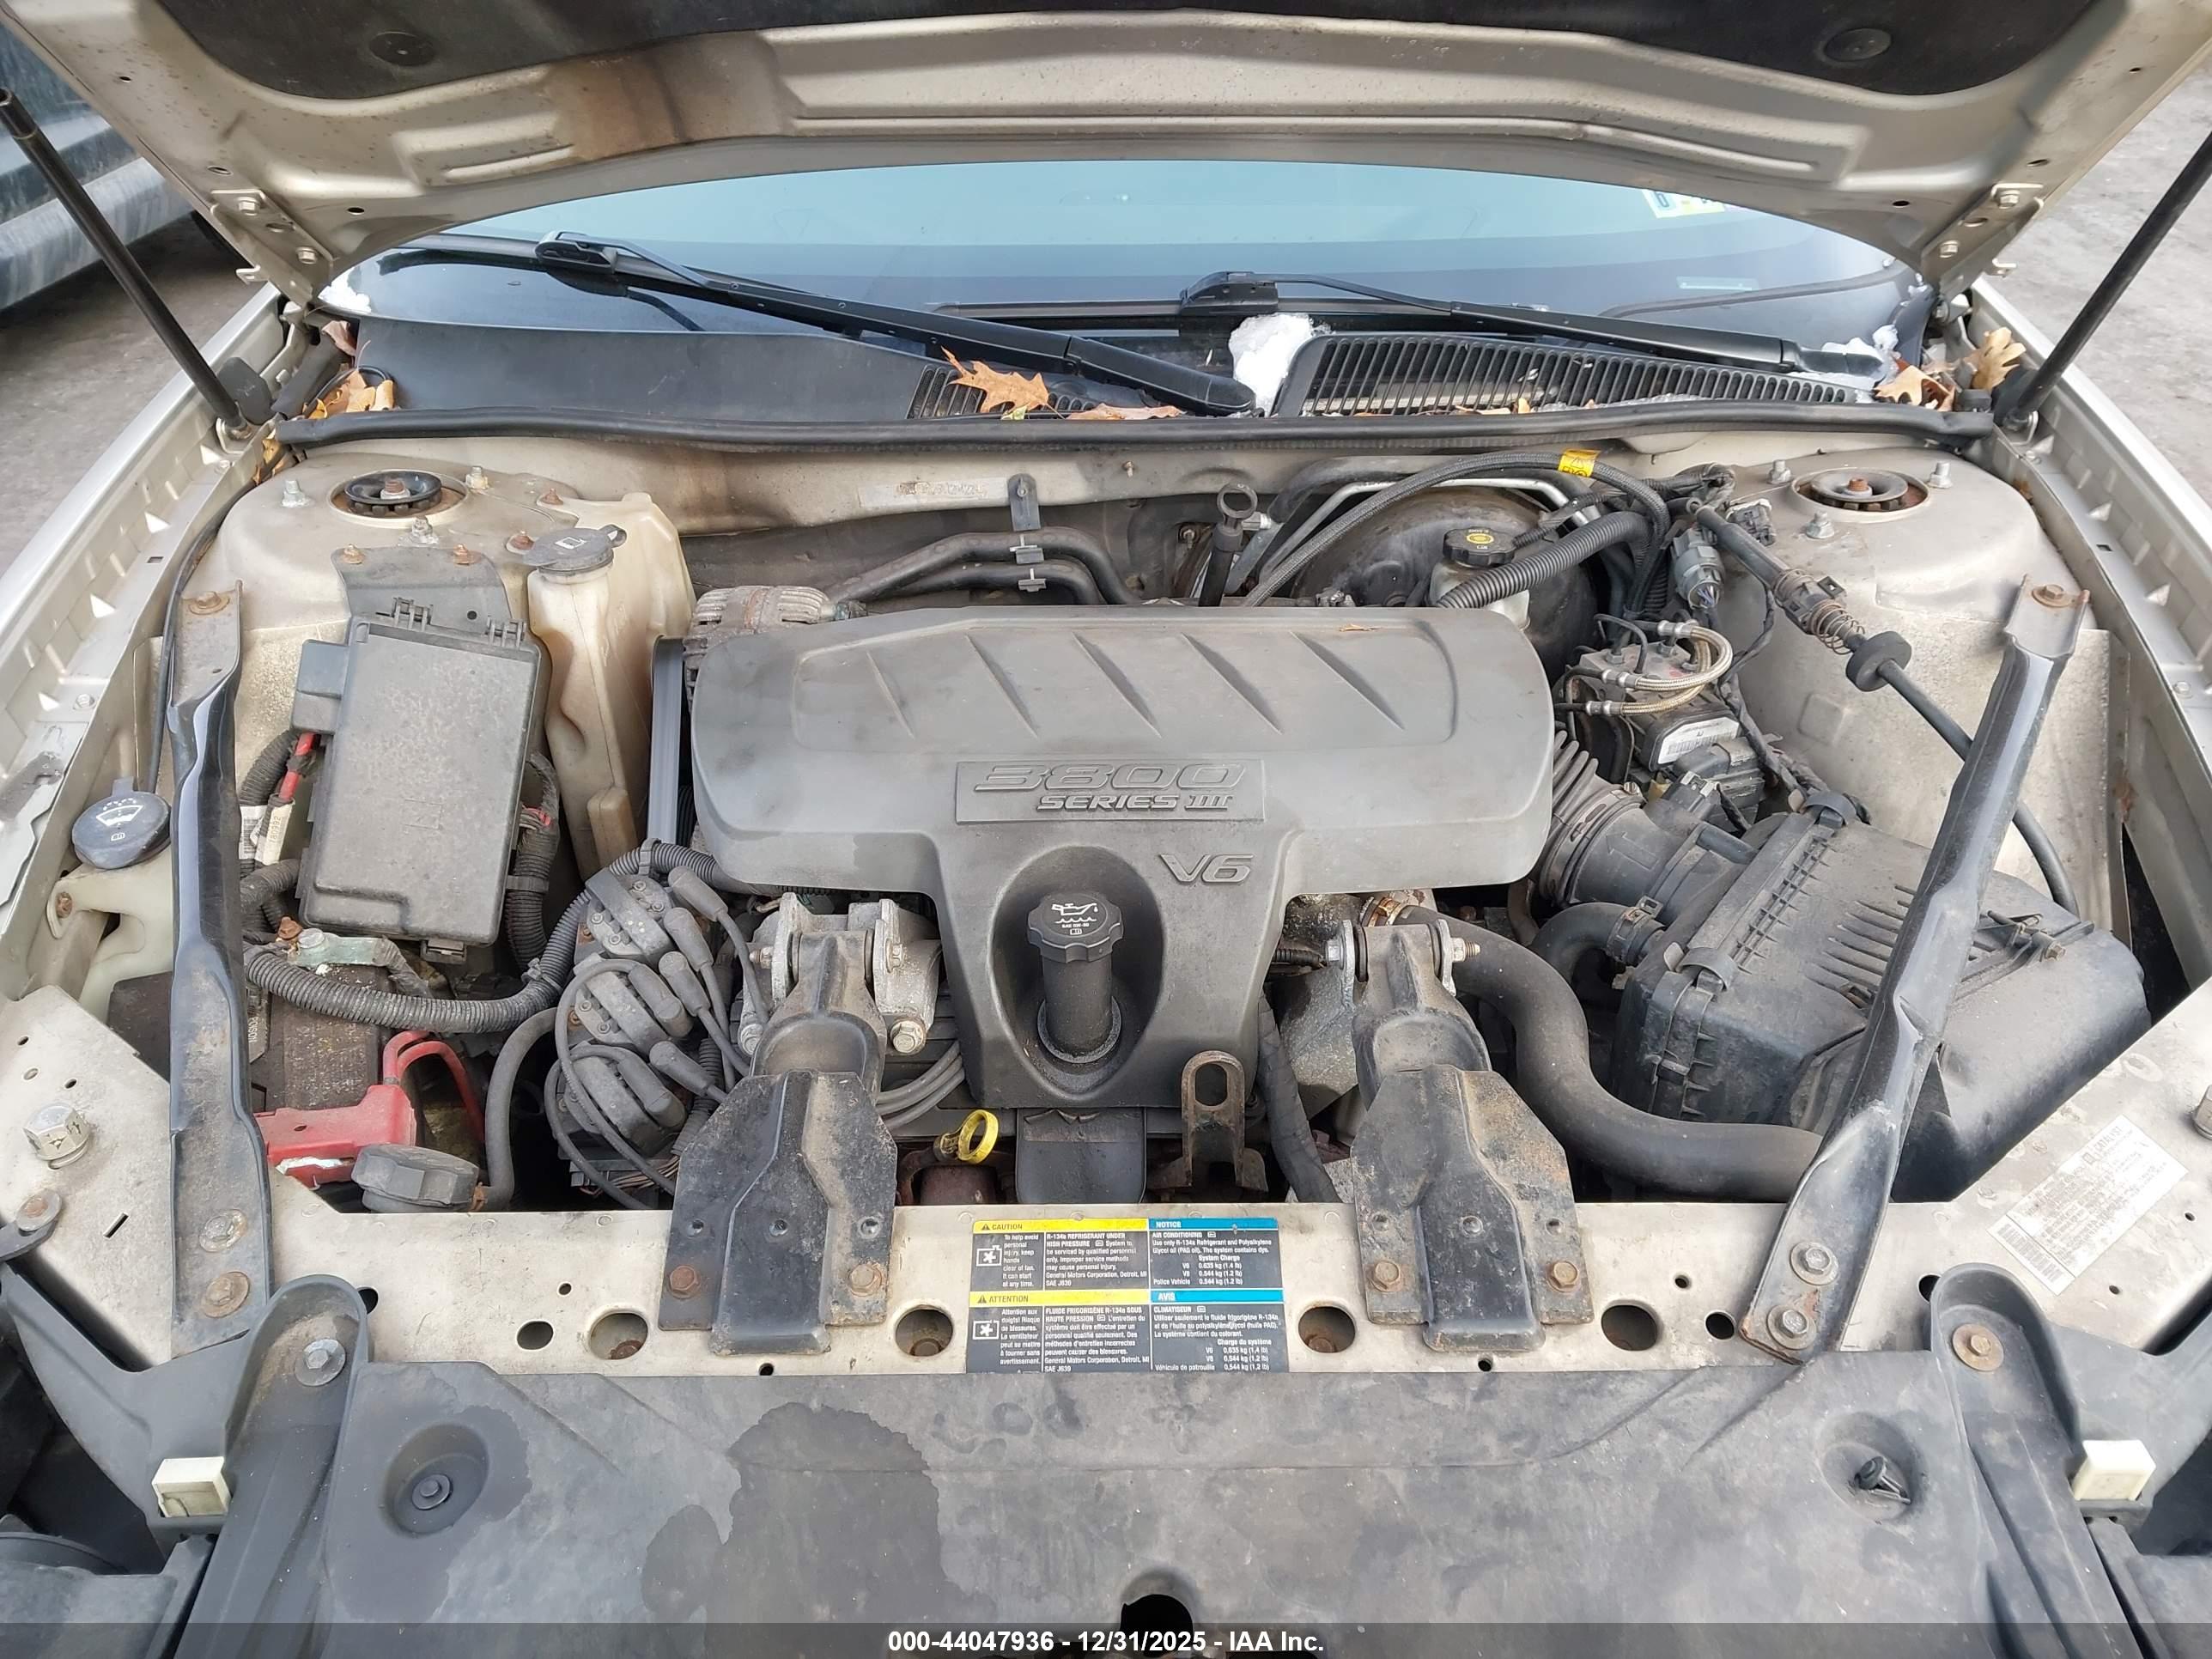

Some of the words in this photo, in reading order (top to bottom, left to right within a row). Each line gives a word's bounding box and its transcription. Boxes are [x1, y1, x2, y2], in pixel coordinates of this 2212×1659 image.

[975, 764, 1246, 792] 3800
[1037, 795, 1179, 811] SERIES
[1185, 795, 1232, 811] III
[1159, 854, 1255, 884] V6
[1158, 1293, 1175, 1301] AVIS
